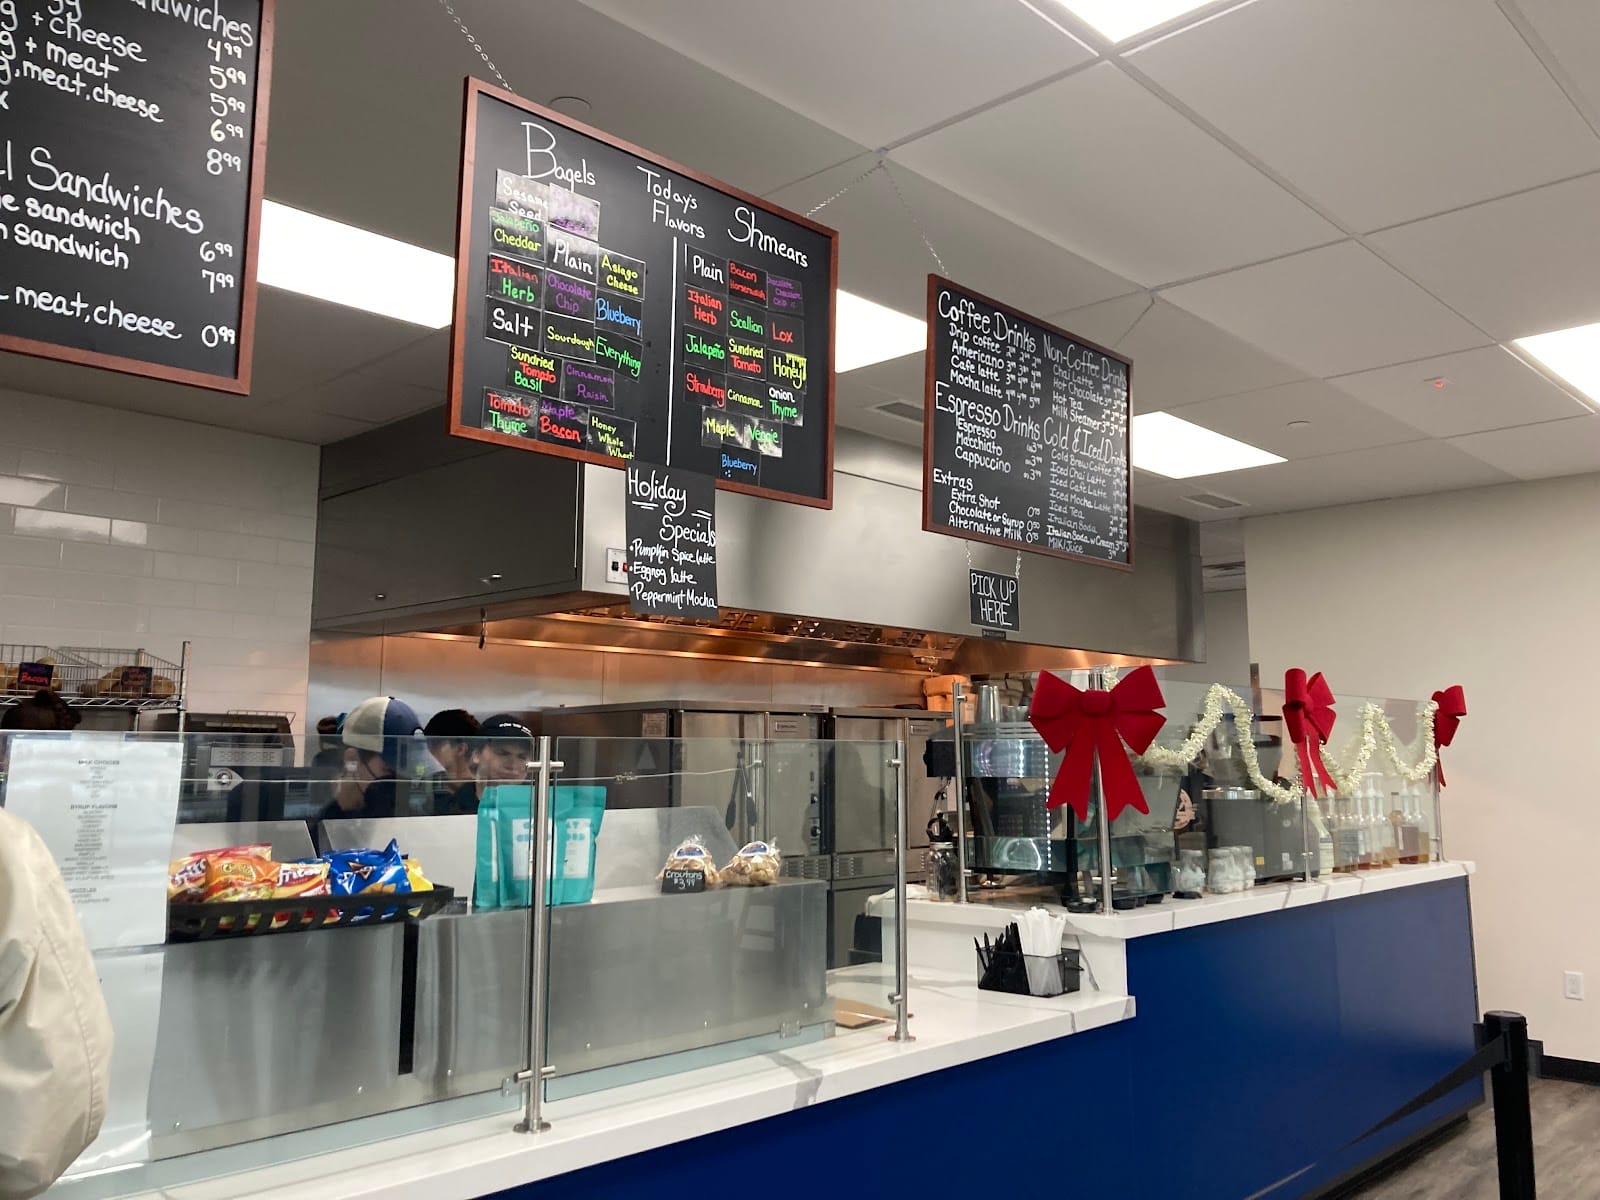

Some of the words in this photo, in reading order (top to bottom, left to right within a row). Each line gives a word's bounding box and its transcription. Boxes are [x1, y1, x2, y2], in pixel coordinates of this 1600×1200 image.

[49, 12, 147, 62] cheese
[46, 41, 120, 79] meat
[521, 122, 596, 193] Bagels
[27, 146, 204, 233] Sandwiches
[637, 166, 697, 214] Today's
[25, 197, 141, 244] sandwich
[508, 200, 542, 221] Seed
[653, 199, 705, 239] Flavors
[494, 227, 542, 252] Cheddar
[728, 207, 809, 268] Shmears
[553, 238, 593, 275] Plain
[602, 255, 638, 280] Asiago
[491, 258, 538, 284] Italian
[693, 255, 724, 284] Plain
[730, 262, 757, 283] Bacon
[503, 278, 535, 302] Herb
[548, 273, 592, 301] Chocolate
[606, 275, 639, 295] Cheese
[555, 293, 579, 315] Chip
[687, 289, 722, 311] Italian
[493, 308, 534, 337] Salt
[596, 298, 641, 336] Blueberry
[693, 305, 717, 326] Herb
[730, 310, 763, 335] Scallion
[938, 291, 991, 334] Coffee
[993, 312, 1037, 353] Drinks
[547, 326, 594, 351] Sourdough
[772, 322, 793, 343] Lox
[949, 322, 969, 349] Drip
[973, 335, 1001, 354] coffee
[595, 335, 641, 377] Everything
[685, 333, 725, 360] Jalapeño
[728, 338, 764, 359] Sundried
[951, 339, 1004, 369] Americano
[511, 347, 554, 371] Sundried
[730, 355, 761, 374] Tomato
[951, 355, 975, 374] Cafe
[514, 370, 543, 393] Basil
[519, 362, 556, 383] Tomato
[566, 364, 614, 384] Cinnamon
[773, 355, 803, 390] Honey
[950, 369, 981, 392] Mocha
[1053, 364, 1070, 380] Chai
[577, 384, 608, 402] Raisin
[686, 373, 725, 408] Strawberry
[727, 389, 763, 408] Cinnamon
[1053, 376, 1067, 391] Hot
[1068, 382, 1104, 405] Chocolate
[1053, 390, 1067, 405] Hot
[1069, 397, 1084, 411] Tea
[488, 393, 530, 417] Tomato
[542, 401, 577, 420] Maple
[769, 399, 798, 421] Thyme
[935, 381, 1001, 427] Espresso
[1003, 403, 1040, 441] Drinks
[489, 410, 528, 434] Thyme
[540, 415, 581, 443] Bacon
[591, 416, 617, 434] Honey
[706, 417, 735, 440] Maple
[957, 417, 996, 440] Espresso
[598, 432, 624, 447] Whole
[955, 431, 1003, 456] Macchiato
[1044, 417, 1069, 450] Cold
[1079, 429, 1104, 461] Iced
[608, 447, 634, 460] Wheat
[721, 453, 757, 476] Blueberry
[955, 446, 1011, 473] Cappuccino
[1051, 448, 1068, 462] Cold
[933, 468, 973, 491] Extras
[1050, 461, 1068, 476] Iced
[1050, 474, 1068, 487] Iced
[628, 466, 687, 517] Holiday
[951, 488, 977, 505] Extra
[979, 494, 1001, 510] Shot
[1050, 488, 1069, 502] Iced
[949, 500, 991, 521] Chocolate
[1001, 512, 1024, 530] Syrup
[1049, 500, 1068, 514] Iced
[1069, 506, 1085, 519] Tea
[659, 514, 717, 549] Specials
[948, 514, 1001, 537] Alternative
[1003, 526, 1022, 541] Milk
[672, 547, 696, 566] Spice
[633, 561, 667, 586] Eggnog
[631, 581, 686, 610] Peppermint
[686, 588, 718, 609] Mocha
[970, 573, 998, 600] PICK
[1000, 579, 1017, 603] UP
[979, 597, 1013, 626] HERE
[665, 870, 703, 880] Croutons
